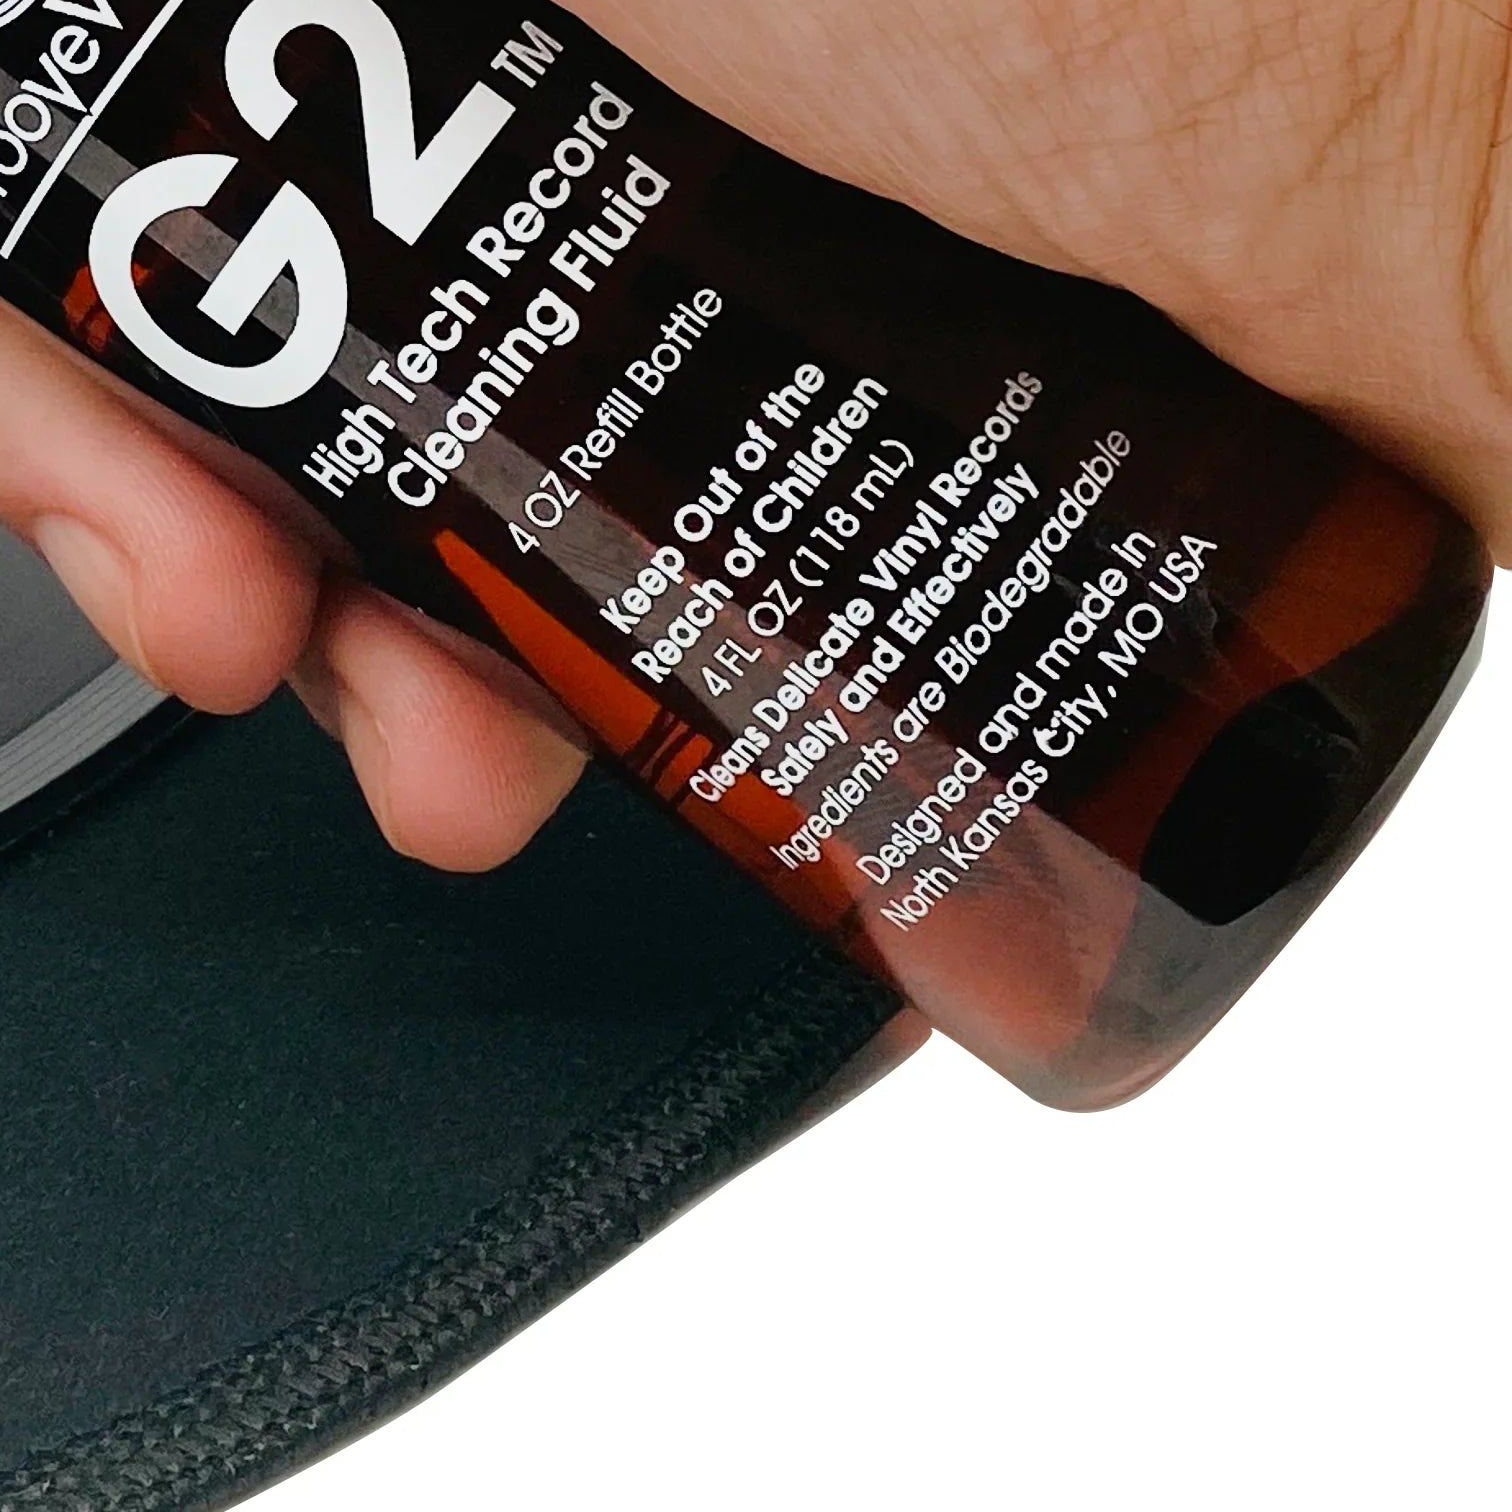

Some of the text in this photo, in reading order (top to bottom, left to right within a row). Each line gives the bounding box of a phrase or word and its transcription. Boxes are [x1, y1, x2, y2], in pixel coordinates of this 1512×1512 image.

[303, 82, 633, 497] High Tech Record
[388, 155, 670, 506] Cleaning Fluid
[509, 289, 721, 553] 4 OZ Refill Bottle
[600, 365, 824, 634] Keep Out of the
[632, 379, 887, 683] Reach of Children
[690, 373, 1041, 801] Cleans Delicate Vinyl Records
[703, 440, 913, 696] 4 FL OZ (118 mL)
[761, 463, 1039, 795] Safely and Effectively
[771, 431, 1129, 869] Ingredients are Biodegradable
[856, 533, 1155, 884] Designed and made in
[881, 868, 958, 930] North
[940, 760, 1047, 870] Kansas
[1098, 603, 1163, 677] MO
[1149, 536, 1217, 602] USA
